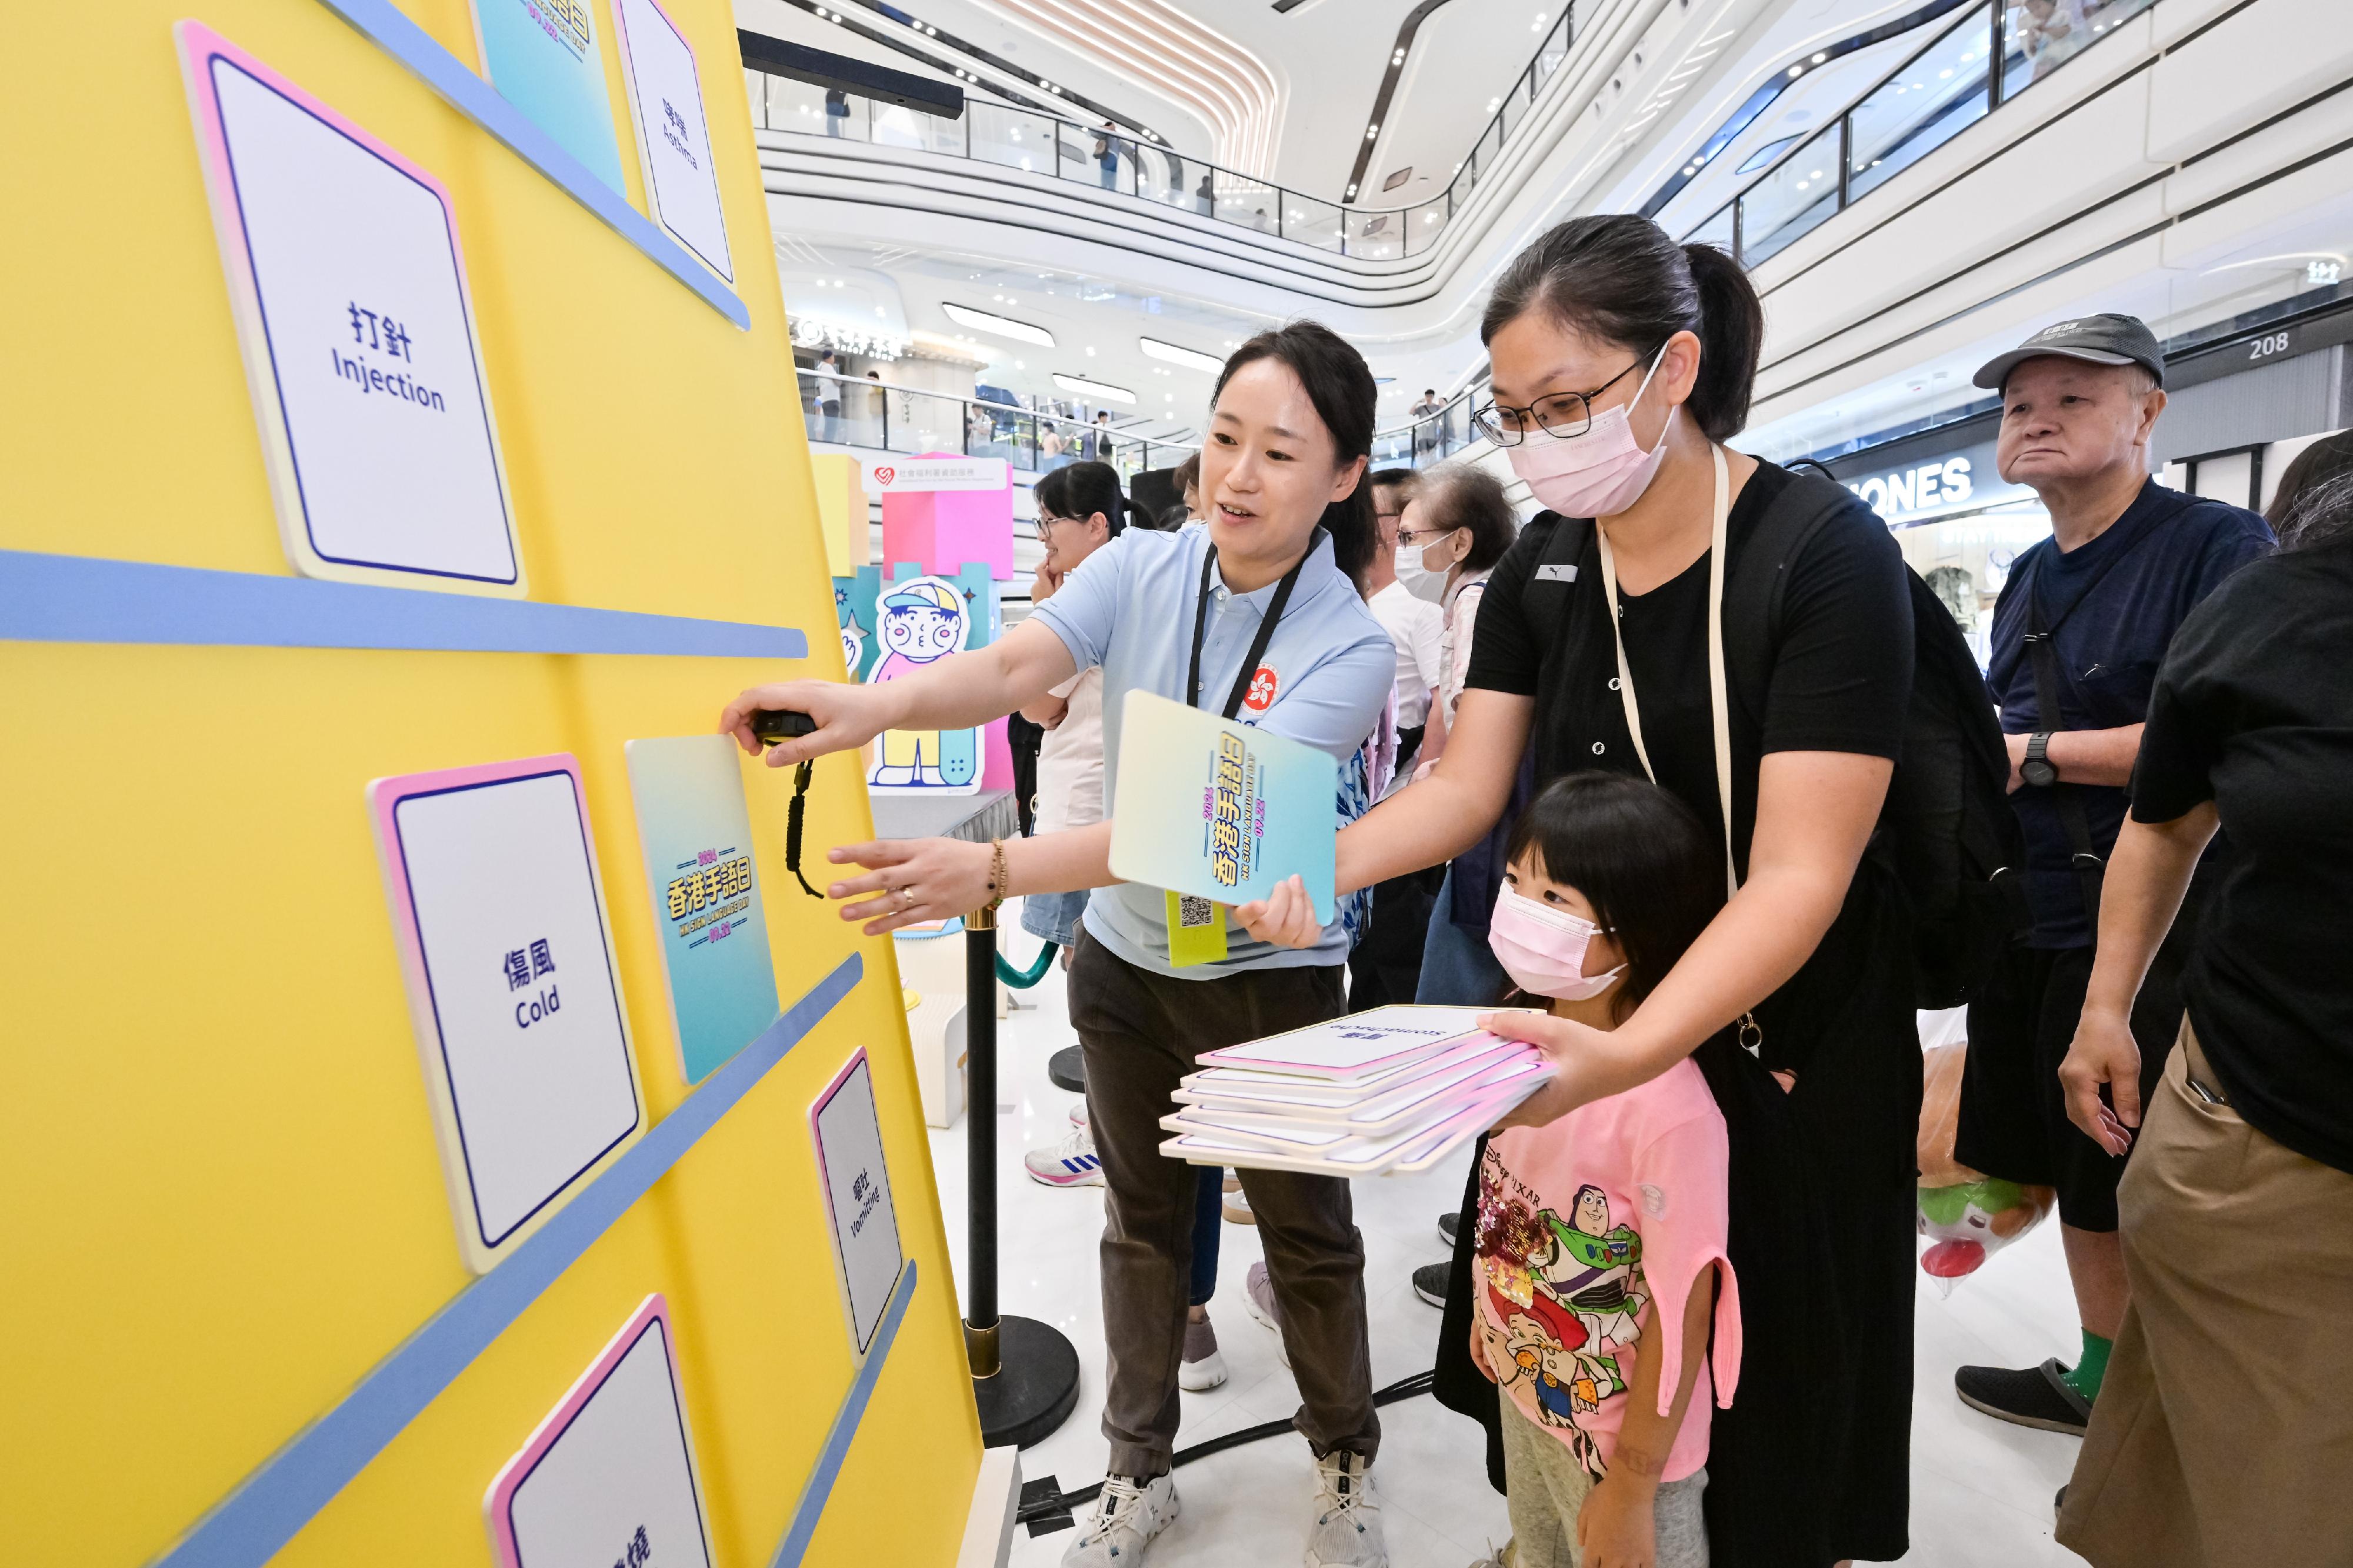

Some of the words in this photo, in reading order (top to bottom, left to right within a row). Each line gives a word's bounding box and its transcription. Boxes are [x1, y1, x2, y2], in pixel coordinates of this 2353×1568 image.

[664, 123, 698, 171] Asthma
[348, 301, 412, 363] 打針
[2249, 332, 2288, 359] 208
[332, 348, 445, 412] Injection
[1850, 457, 1973, 515] ONES
[1202, 787, 1214, 821] 2024
[1212, 730, 1245, 886] 香港手語日
[1244, 775, 1254, 834] LANGUAGE
[1254, 798, 1265, 837] 09.22
[697, 848, 718, 866] 2024
[1242, 834, 1251, 863] SIGN
[668, 856, 752, 921] 香港手語日
[1241, 863, 1249, 881] HK
[679, 922, 690, 937] HK
[689, 915, 706, 932] SIGN
[707, 901, 738, 925] LANGUAGE
[738, 896, 749, 910] DAY
[709, 921, 731, 943] 09.22
[504, 938, 555, 992] 傷風
[516, 984, 560, 1028] Cold
[1330, 1025, 1447, 1036] Stomachache
[853, 1167, 869, 1202] 嘔吐
[851, 1185, 880, 1239] Vomiting
